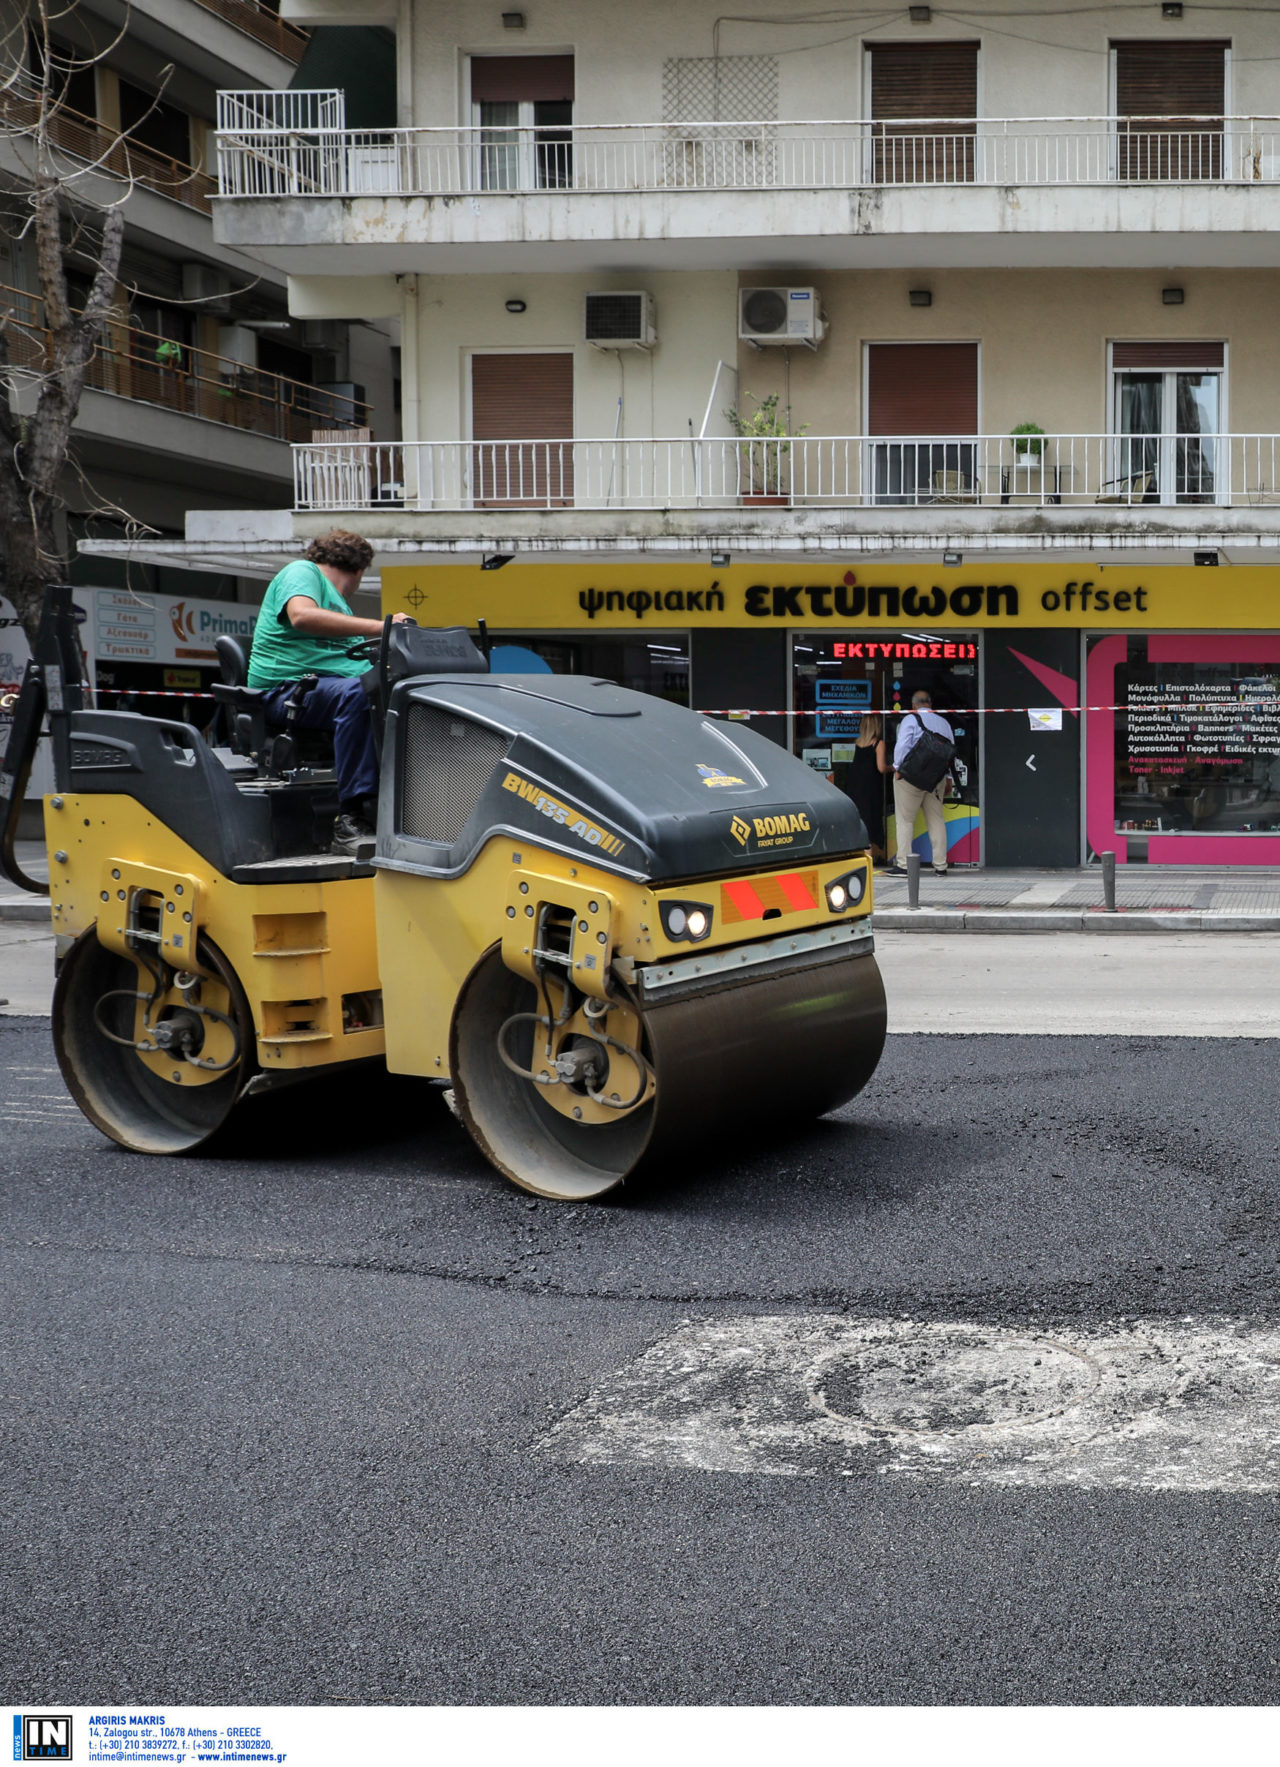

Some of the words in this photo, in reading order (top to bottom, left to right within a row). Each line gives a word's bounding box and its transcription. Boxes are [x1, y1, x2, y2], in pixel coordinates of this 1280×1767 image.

[579, 580, 724, 619] ψηφιακή
[744, 572, 1019, 617] εκτύπωση
[1040, 582, 1148, 612] offset
[1128, 684, 1158, 692] Κάρτες
[1166, 684, 1231, 692] Επιστολόχαρτα
[1239, 684, 1276, 692] Φάκελοι
[1128, 694, 1181, 703] Μονόφυλλα
[1189, 694, 1237, 703] Πολύπτυχα
[1205, 704, 1254, 713] Εφημερίδες
[1128, 714, 1172, 722] Περιοδικά
[1180, 714, 1243, 723] Τιμοκατάλογοι
[1128, 724, 1190, 733] Προσκλητήρια
[1242, 724, 1278, 733] Μακέτες
[1128, 734, 1186, 742] Αυτοκόλλητα
[1194, 734, 1244, 743] Φωτοτυπίες
[1128, 745, 1178, 753] Χρυσοτυπία
[1186, 745, 1219, 753] Γκοφρέ
[1226, 745, 1256, 754] Ειδικές
[1160, 766, 1184, 775] Inkjet
[501, 772, 539, 804] BW
[535, 796, 570, 825] 135
[568, 820, 602, 846] AD
[752, 812, 810, 838] BOMAG
[758, 839, 774, 848] FAYAT
[775, 836, 794, 845] GROUP
